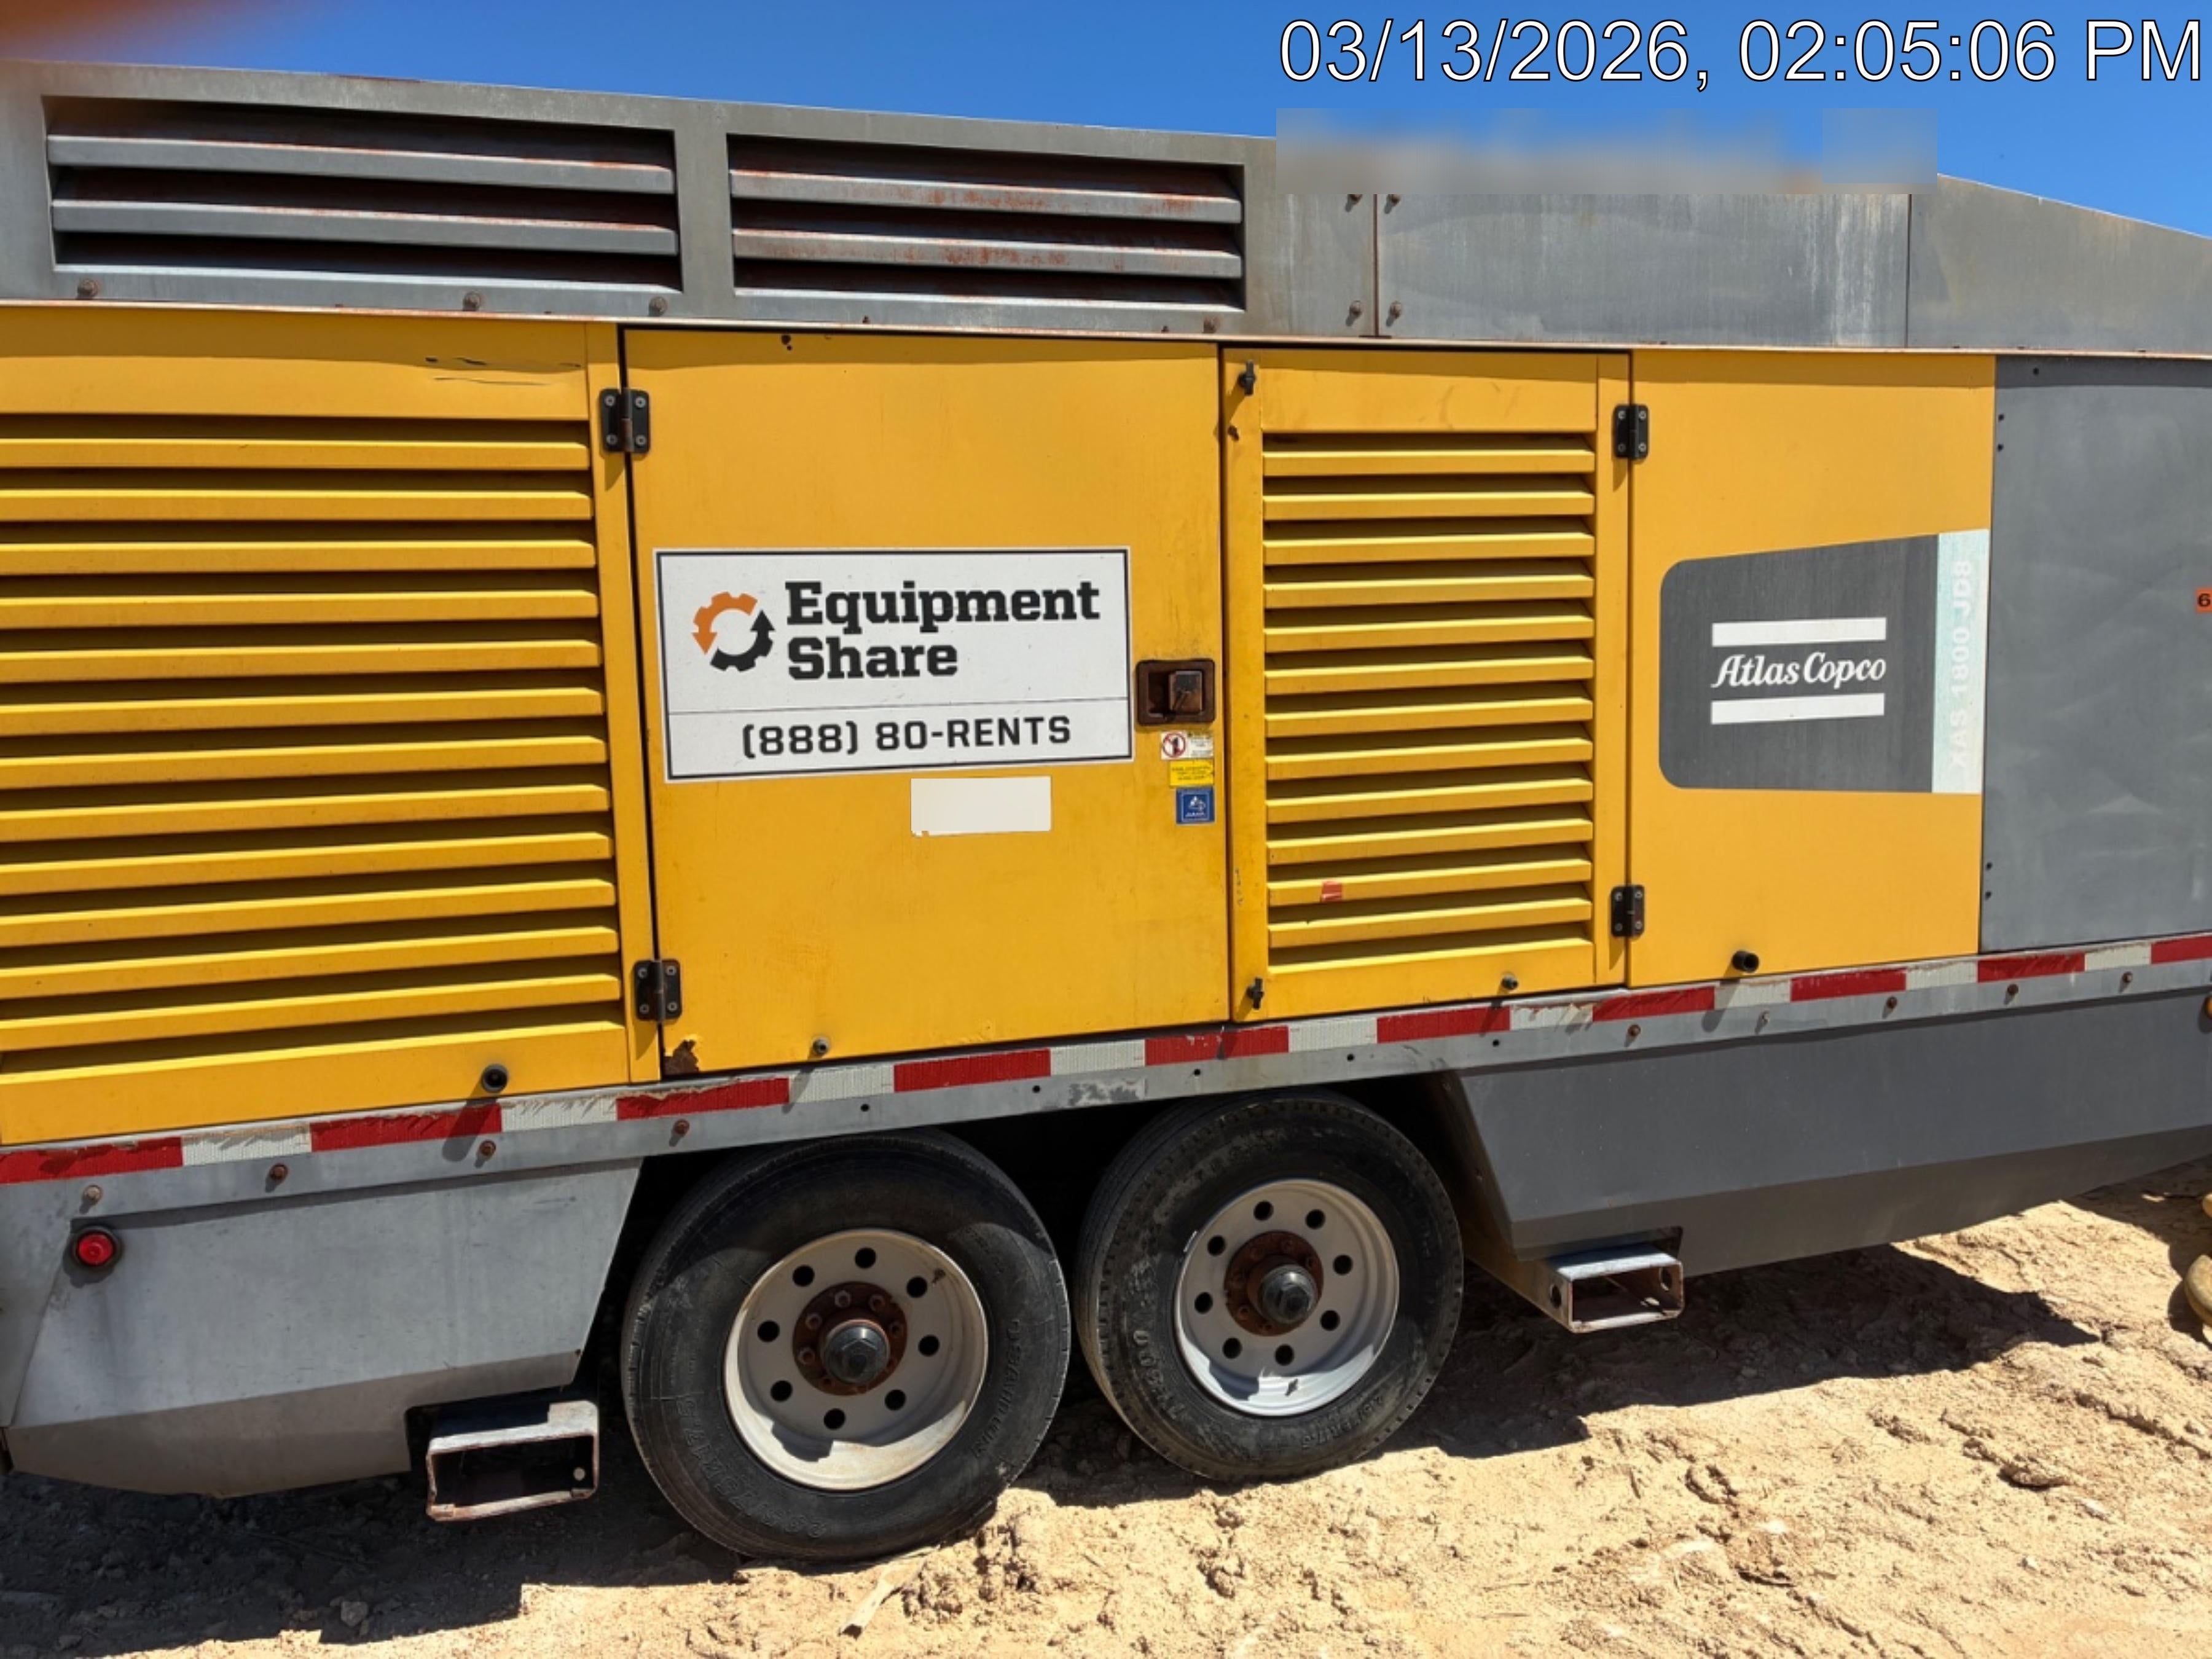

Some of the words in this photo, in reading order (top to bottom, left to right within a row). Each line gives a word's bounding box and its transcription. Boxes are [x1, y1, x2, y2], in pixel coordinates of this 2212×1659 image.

[785, 581, 1100, 633] Equipment
[788, 637, 958, 680] Share
[1710, 654, 1800, 688] Atlas
[1803, 651, 1886, 689] Copco
[1951, 627, 1971, 697] 1800
[743, 721, 858, 759] (888)
[875, 715, 1071, 751] 80-RENTS
[1949, 710, 1967, 770] XAS
